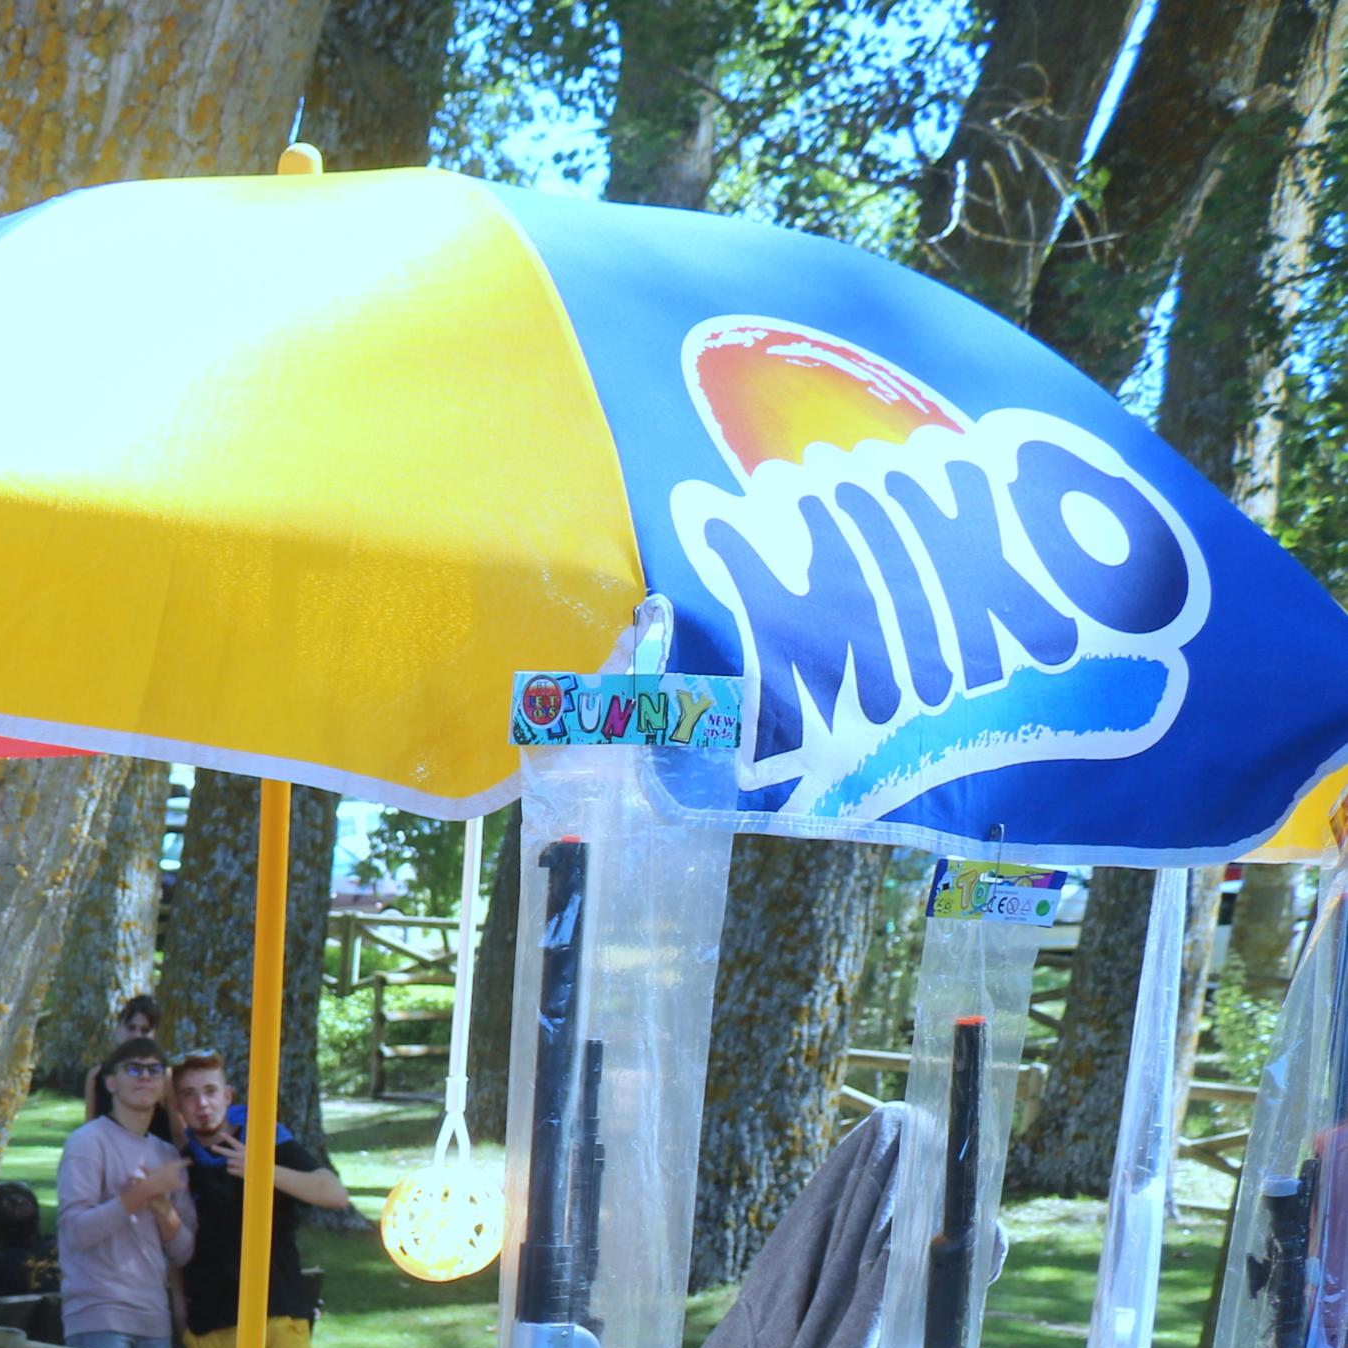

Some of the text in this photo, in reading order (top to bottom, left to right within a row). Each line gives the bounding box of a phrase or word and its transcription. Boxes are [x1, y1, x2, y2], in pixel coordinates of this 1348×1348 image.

[701, 437, 1191, 766] MIKO
[548, 675, 714, 745] FUNNY
[708, 713, 736, 727] NEW
